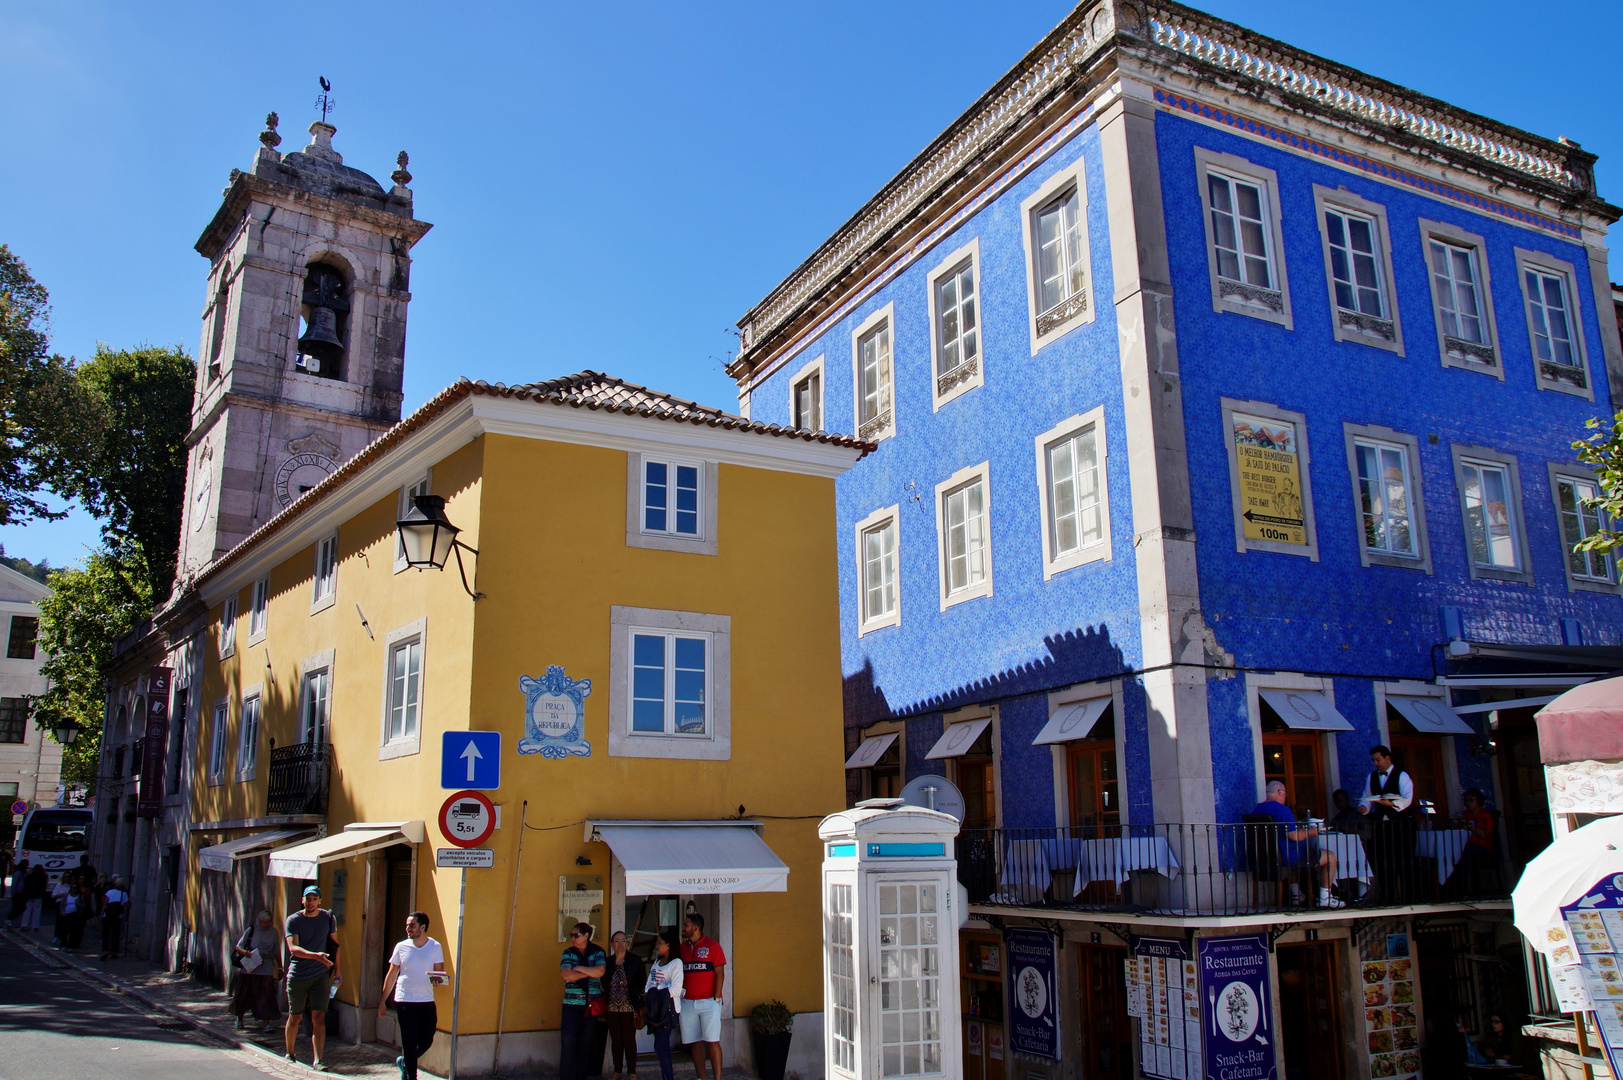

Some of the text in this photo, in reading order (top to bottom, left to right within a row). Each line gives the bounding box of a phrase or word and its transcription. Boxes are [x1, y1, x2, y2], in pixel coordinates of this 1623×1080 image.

[1244, 448, 1262, 458] MELHOR
[1264, 461, 1271, 470] DO
[1251, 473, 1260, 481] BEST
[1261, 475, 1276, 483] BURGER
[1248, 496, 1269, 507] TAKE AWAY
[1260, 528, 1289, 541] 100m
[545, 703, 564, 711] PRAÇA
[538, 720, 570, 729] REPÚBLICA
[456, 822, 475, 833] 5,5t
[1010, 940, 1052, 956] Restaurante
[1149, 944, 1171, 955] MENU
[1205, 954, 1264, 969] Restaurante
[1016, 1023, 1051, 1040] Snack-Bar
[1018, 1036, 1049, 1052] Cafetaria
[1215, 1049, 1265, 1067] Snack-Bar
[1220, 1063, 1263, 1080] Cafetaria
